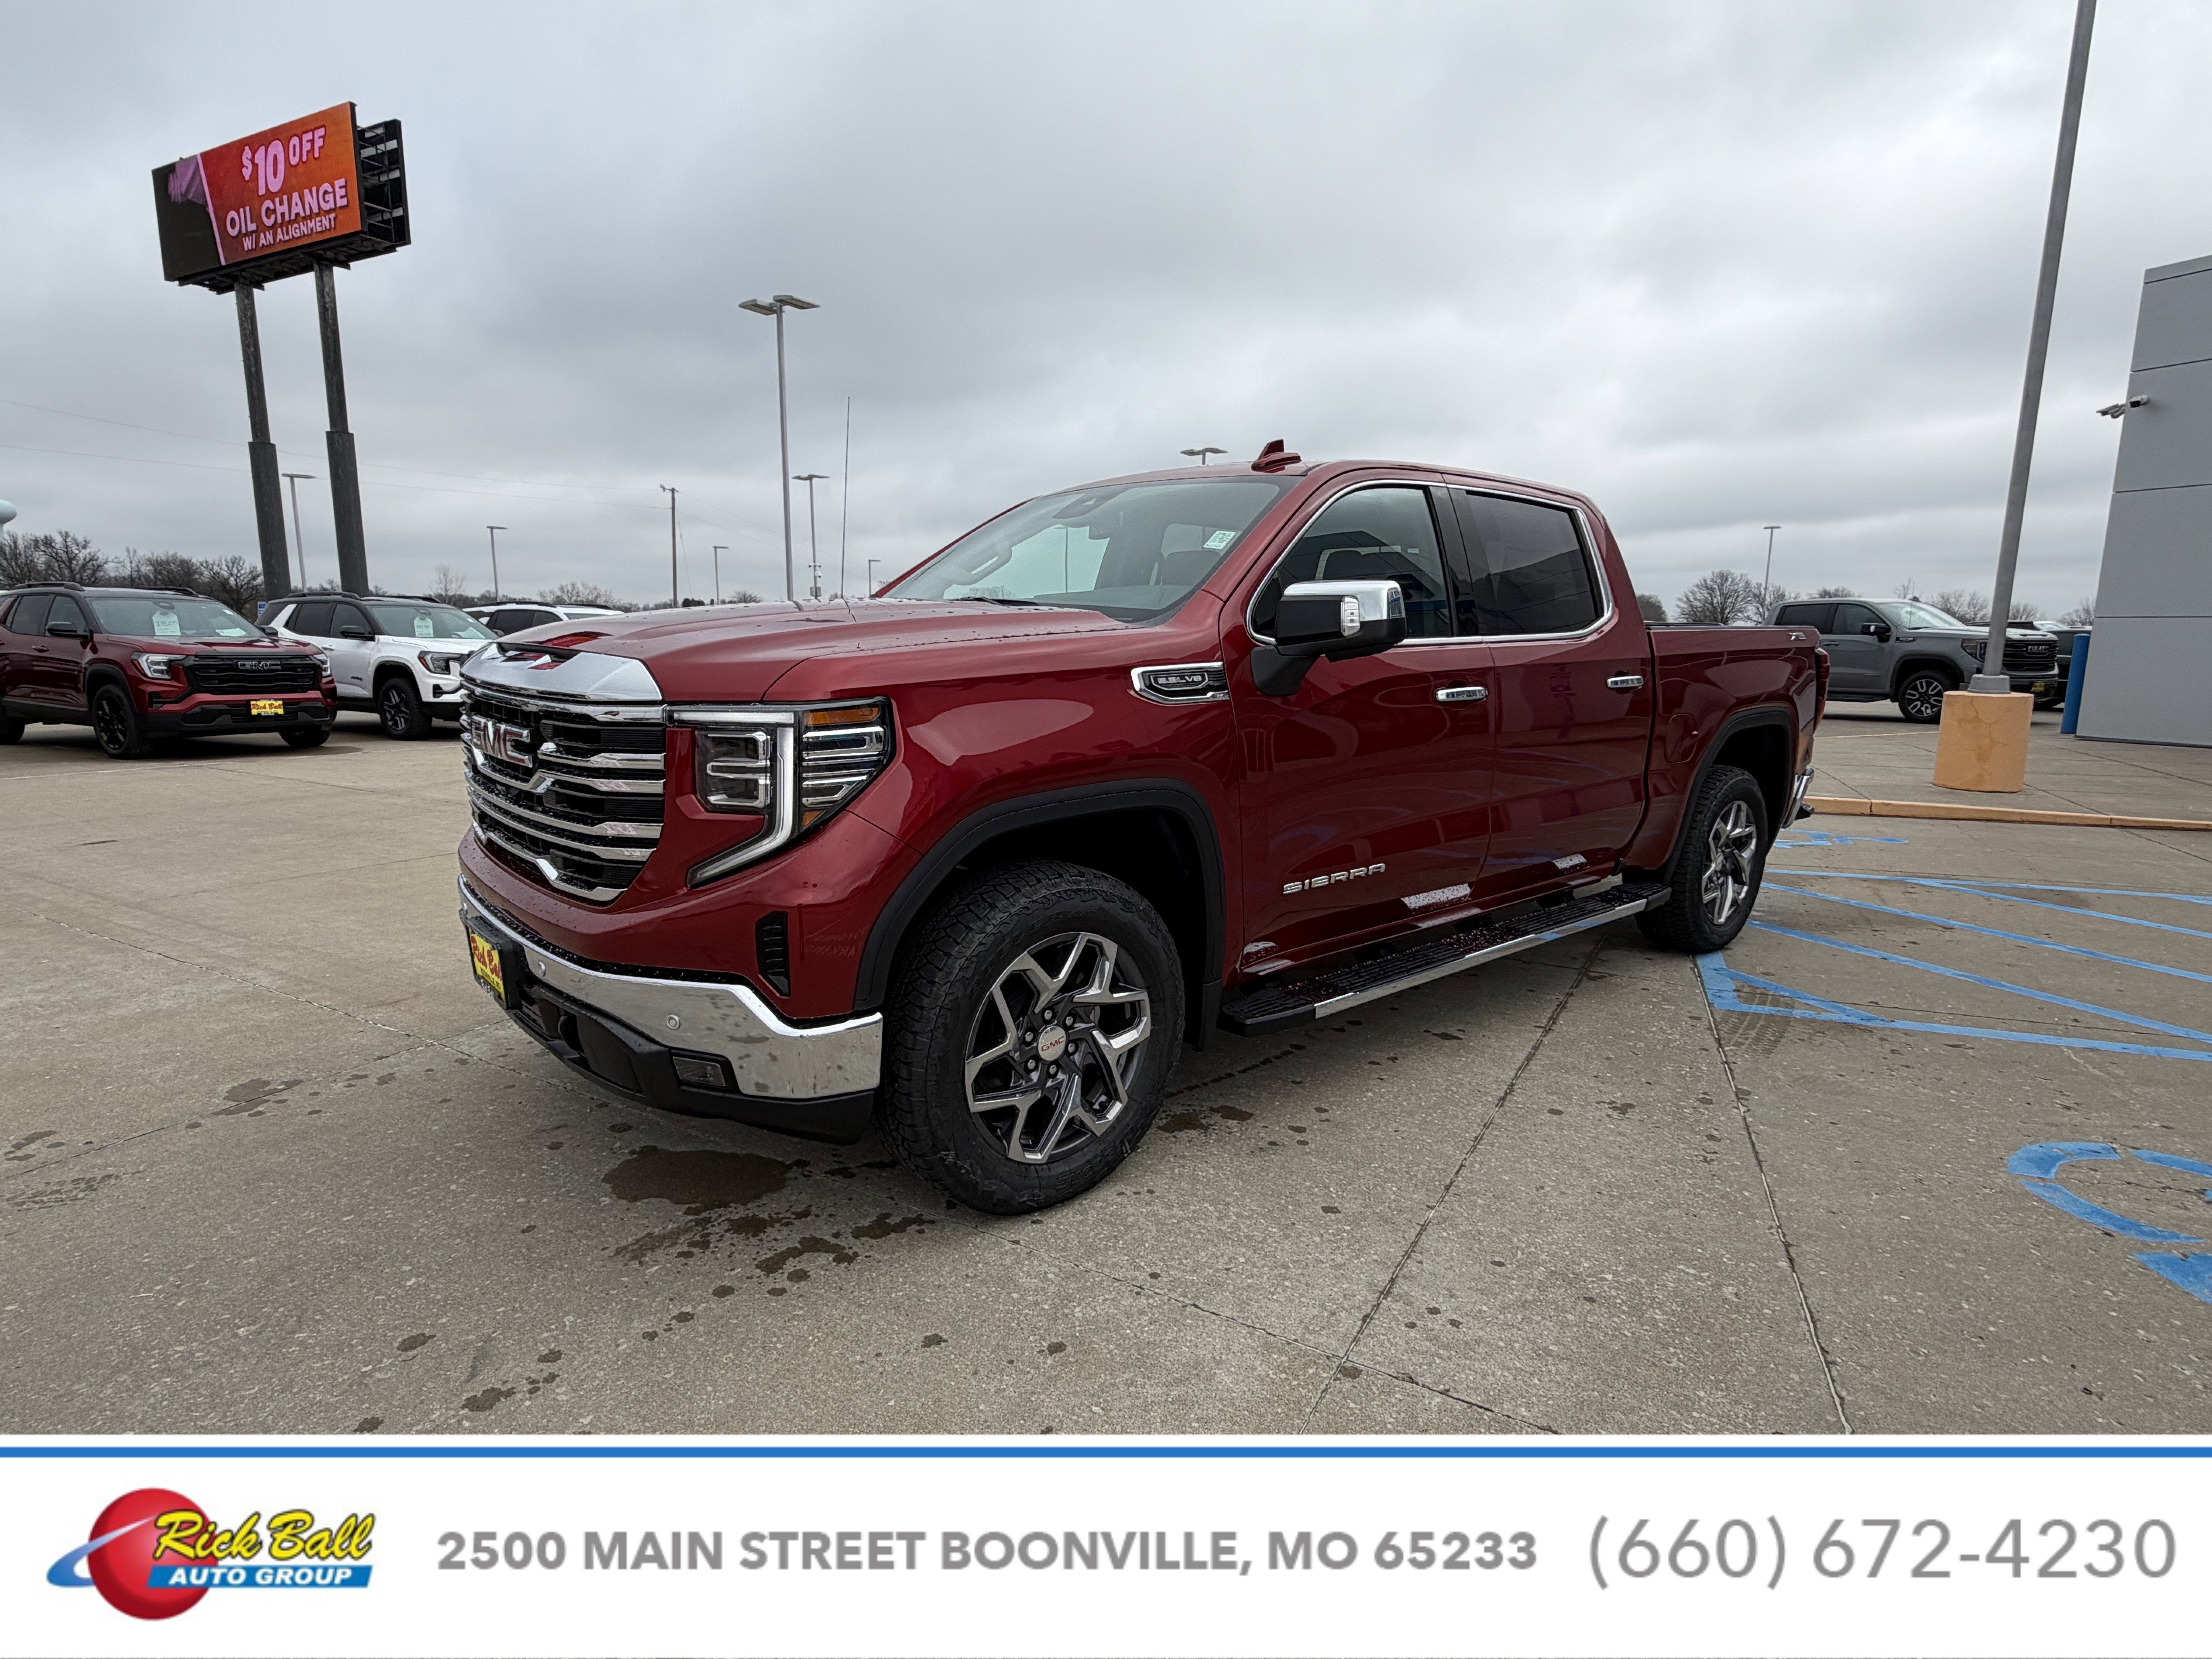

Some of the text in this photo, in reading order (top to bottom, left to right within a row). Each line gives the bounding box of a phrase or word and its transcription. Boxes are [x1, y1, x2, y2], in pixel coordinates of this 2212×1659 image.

[242, 127, 326, 195] $10 OFF
[226, 178, 348, 237] OIL CHANGE
[242, 214, 336, 251] W/ AN ALIGNMENT
[238, 661, 282, 670] GMC
[471, 715, 532, 768] GMC
[1283, 863, 1386, 894] SIERRA
[1041, 1036, 1064, 1051] GMC
